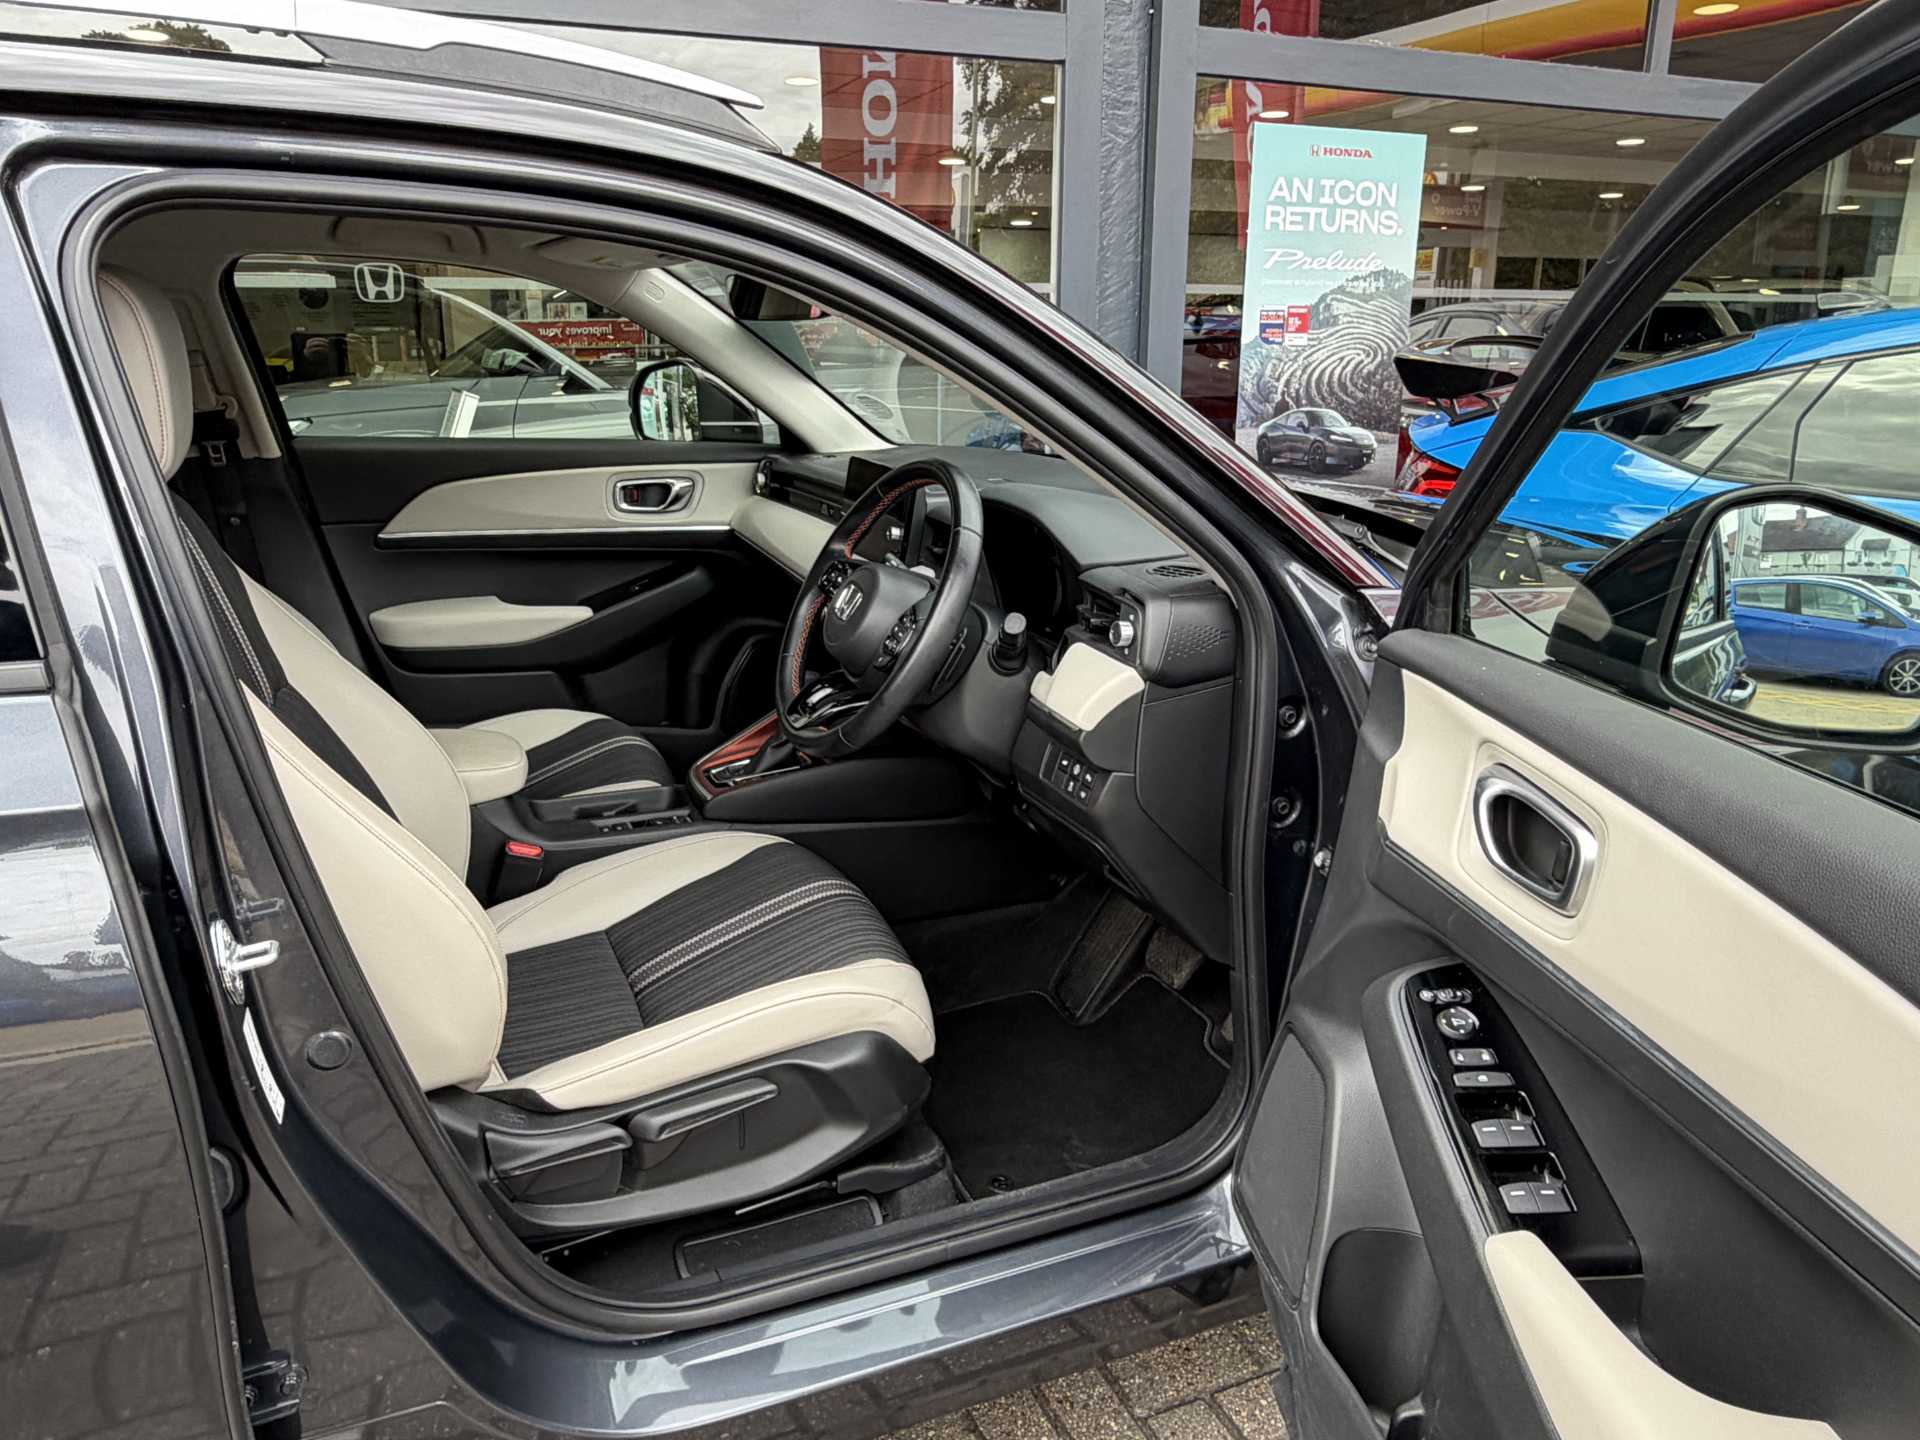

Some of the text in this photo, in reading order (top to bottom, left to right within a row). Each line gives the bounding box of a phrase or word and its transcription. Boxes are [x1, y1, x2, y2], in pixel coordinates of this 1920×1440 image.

[1322, 147, 1373, 159] HONDA
[1267, 176, 1313, 204] AN
[1319, 180, 1399, 208] ICON
[1264, 205, 1403, 236] RETURNS.
[1263, 248, 1382, 272] Prelude
